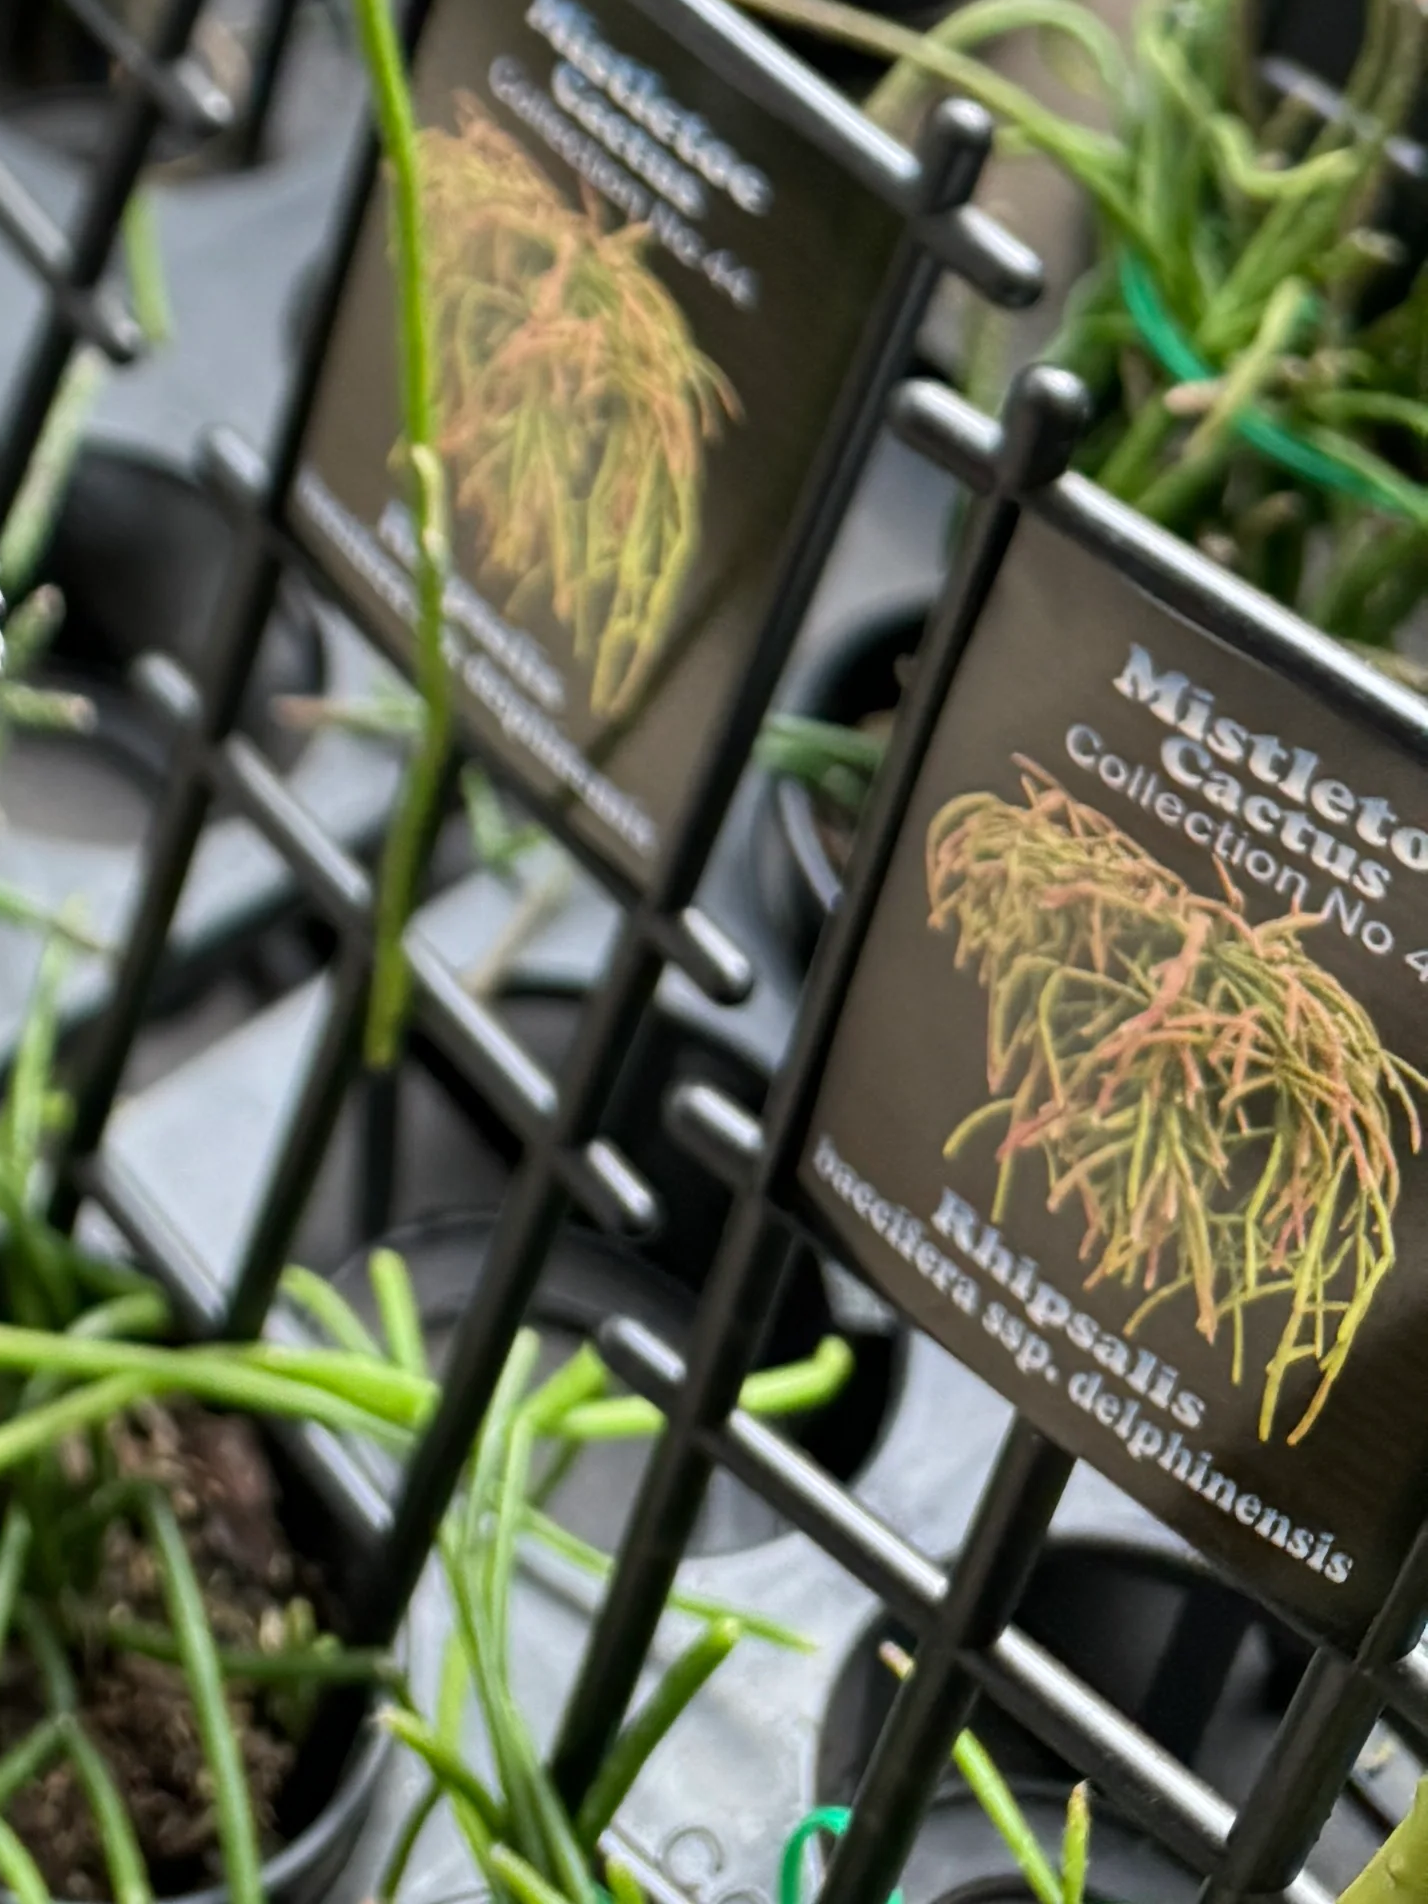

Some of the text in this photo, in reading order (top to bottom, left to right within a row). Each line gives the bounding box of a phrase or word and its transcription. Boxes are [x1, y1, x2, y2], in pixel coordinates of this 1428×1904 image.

[1065, 723, 1310, 904] Collection
[1320, 886, 1394, 955] No
[1112, 641, 1428, 872] Mistleto
[1159, 734, 1392, 900] Cactus
[930, 1185, 1208, 1430] Rhipsalis
[981, 1302, 1059, 1385] ssp.
[1066, 1371, 1355, 1585] delphinensis
